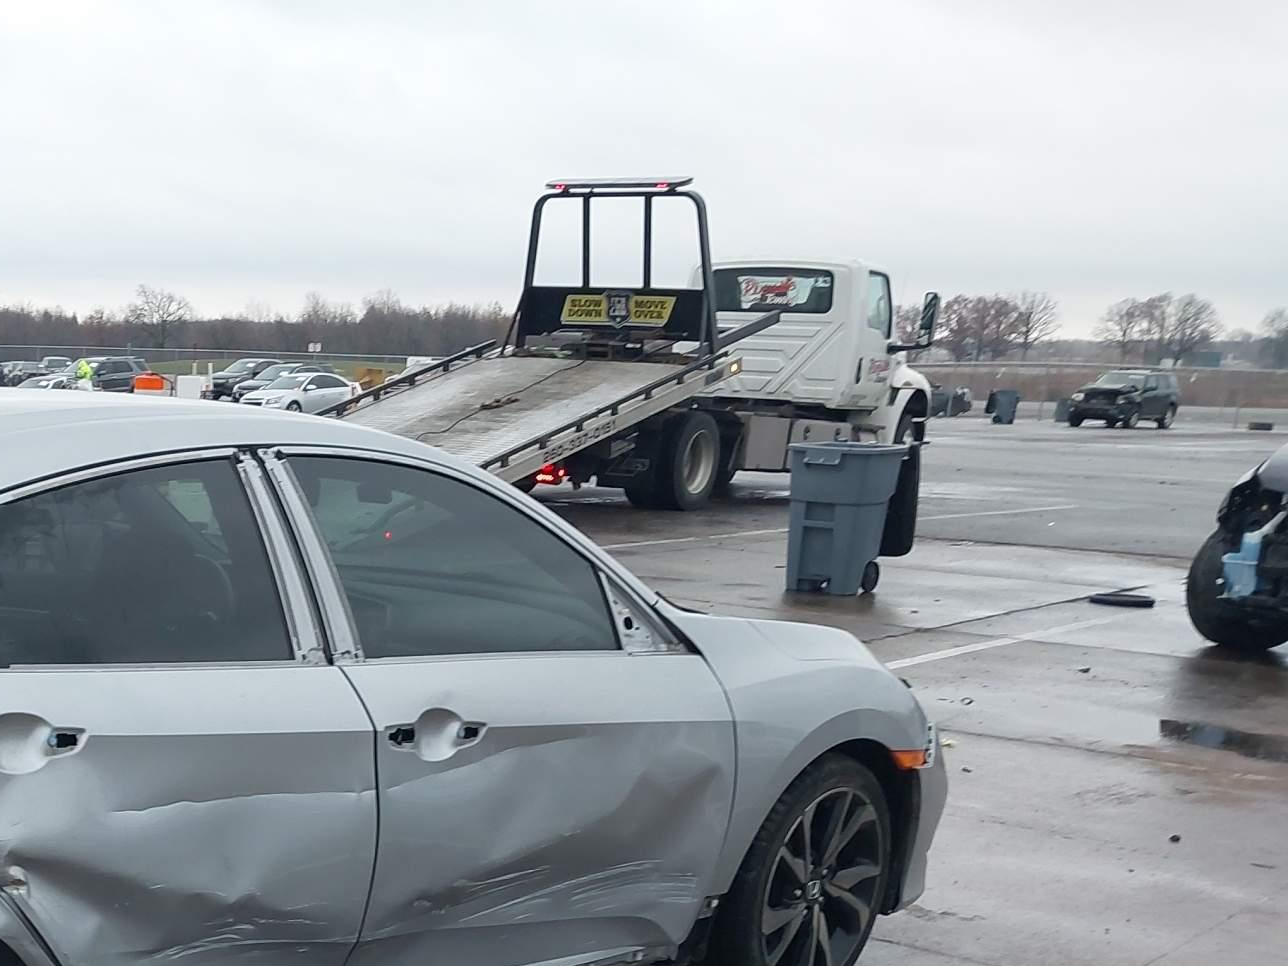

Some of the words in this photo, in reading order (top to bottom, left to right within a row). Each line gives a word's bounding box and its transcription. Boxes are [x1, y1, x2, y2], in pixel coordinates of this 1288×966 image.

[571, 299, 602, 308] SLOW
[634, 300, 667, 309] MOVE
[568, 309, 601, 318] DOWN
[634, 310, 664, 319] OVER
